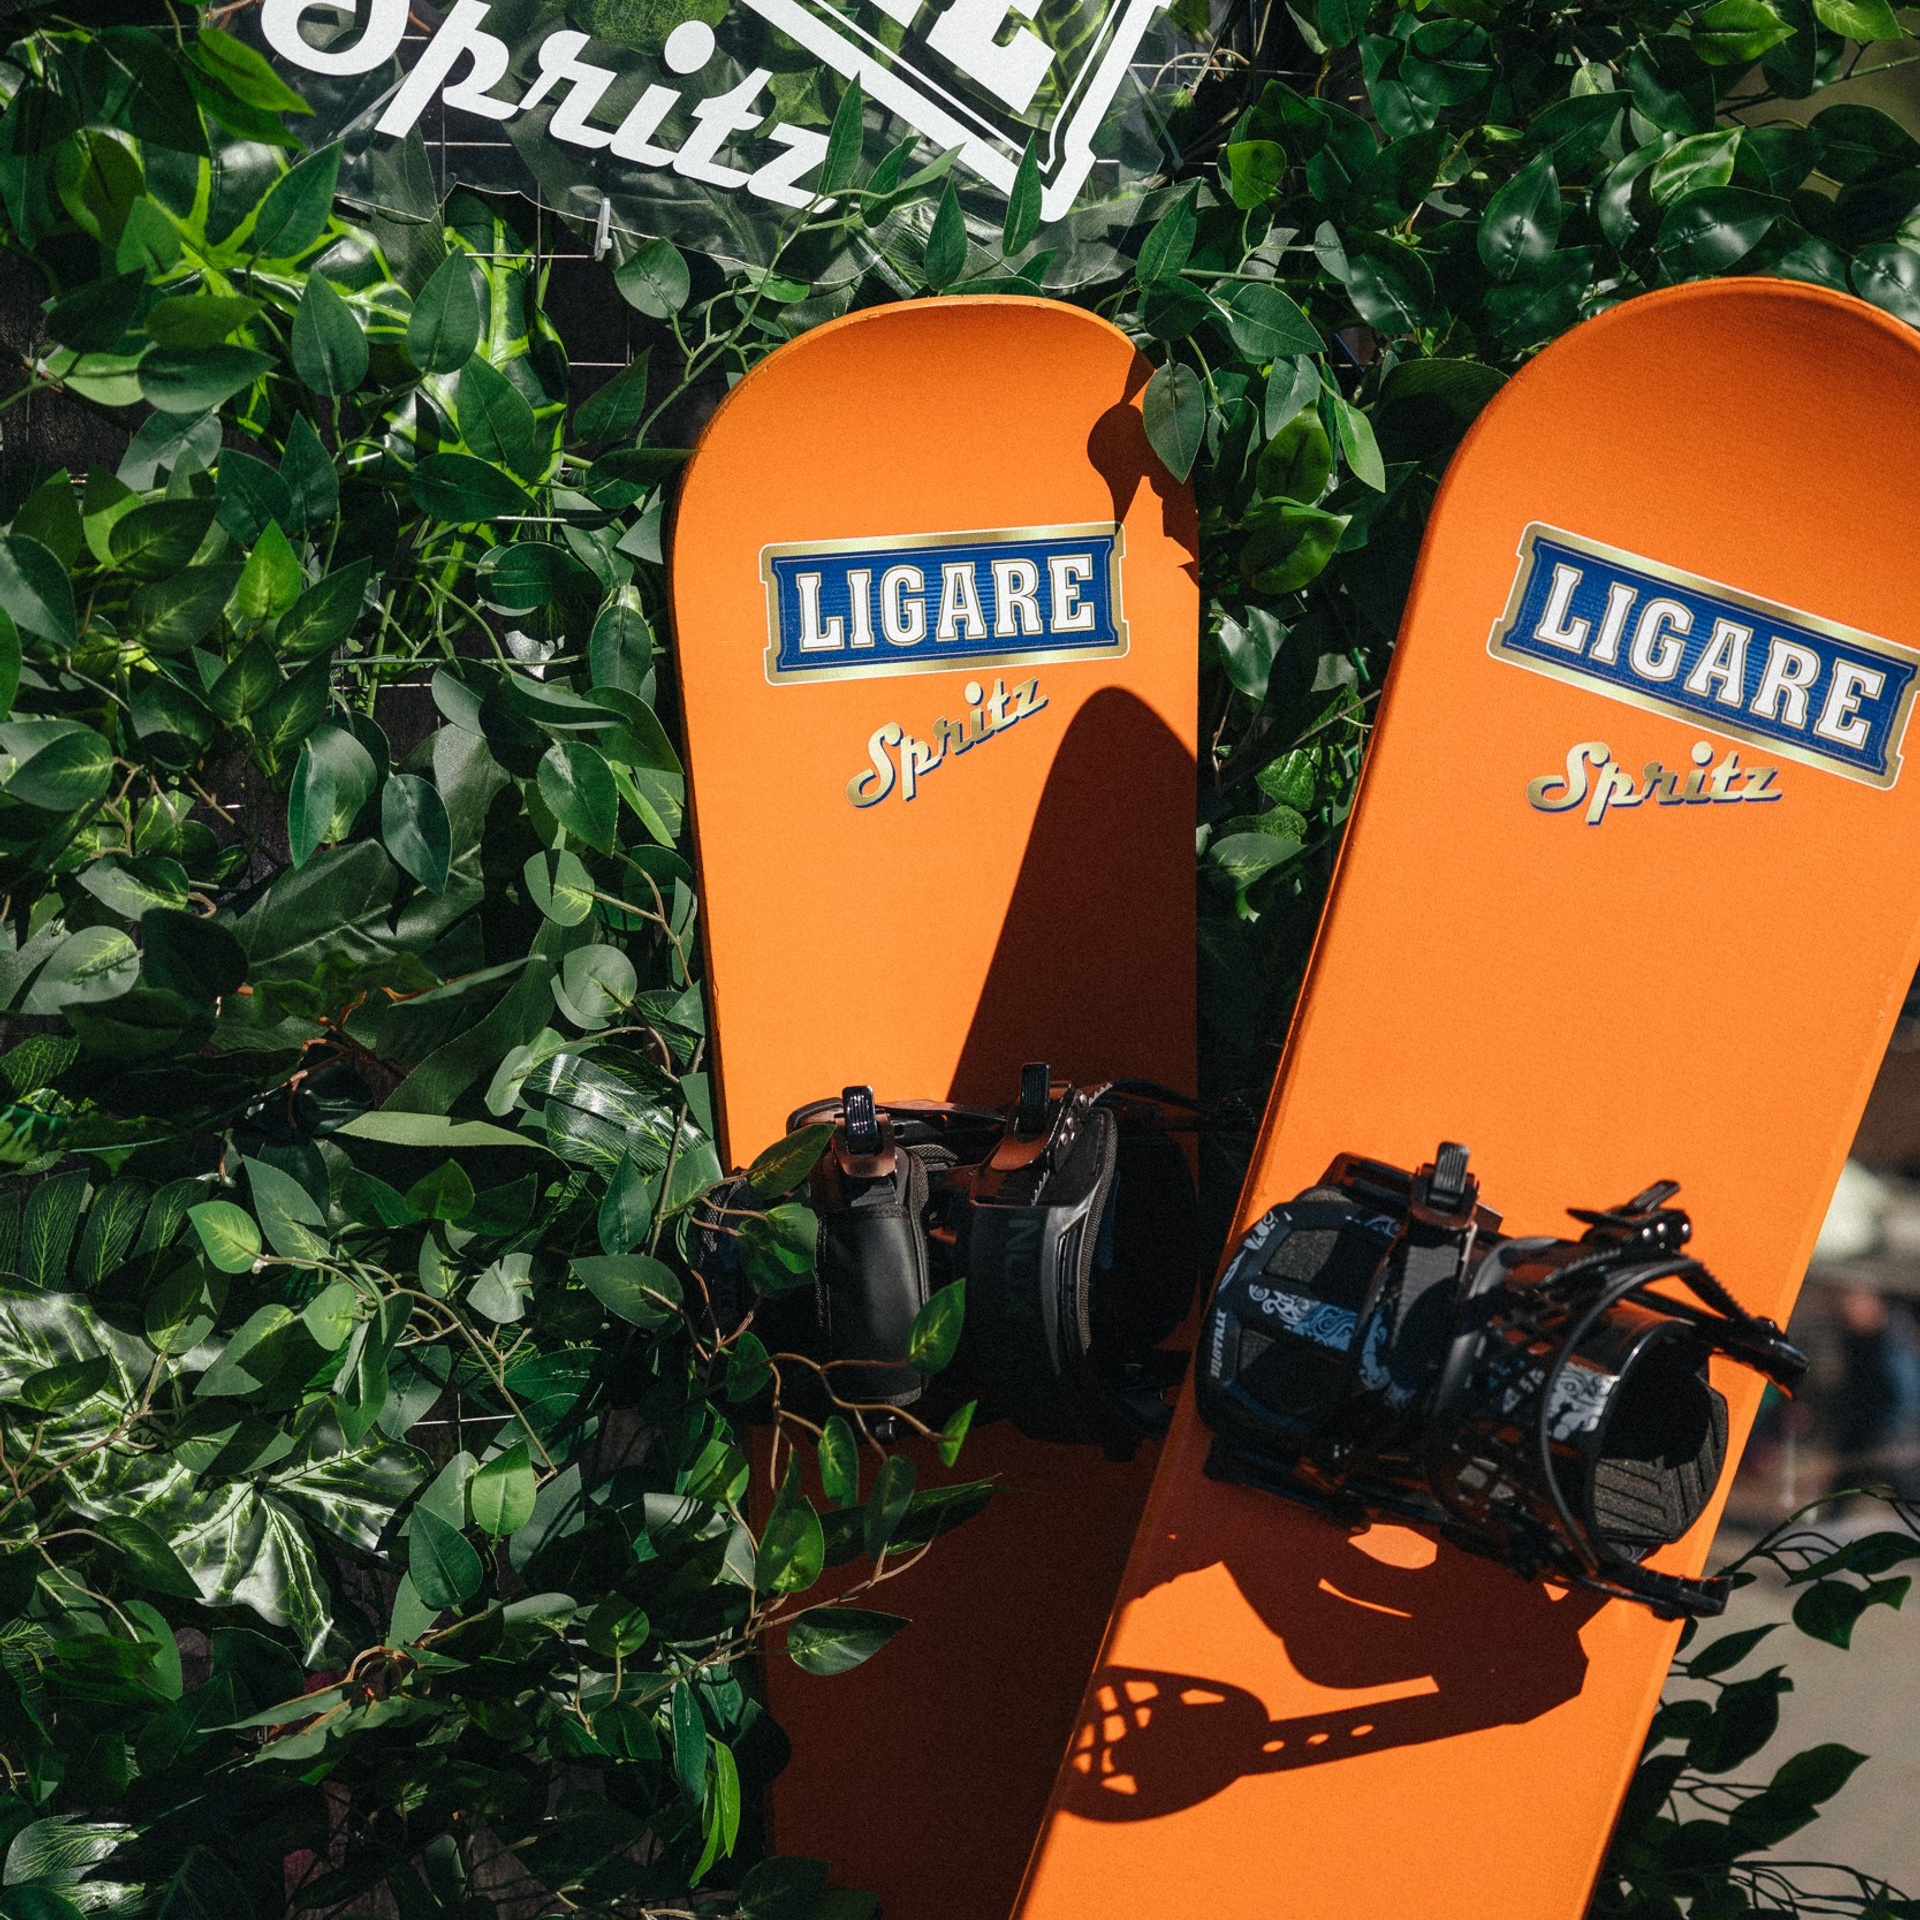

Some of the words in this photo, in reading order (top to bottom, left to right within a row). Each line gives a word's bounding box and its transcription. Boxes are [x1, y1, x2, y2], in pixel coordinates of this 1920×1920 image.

[795, 553, 1095, 652] LIGARE
[1533, 562, 1887, 750] LIGARE
[845, 677, 1049, 808] Spritz
[1526, 741, 1782, 825] Spritz
